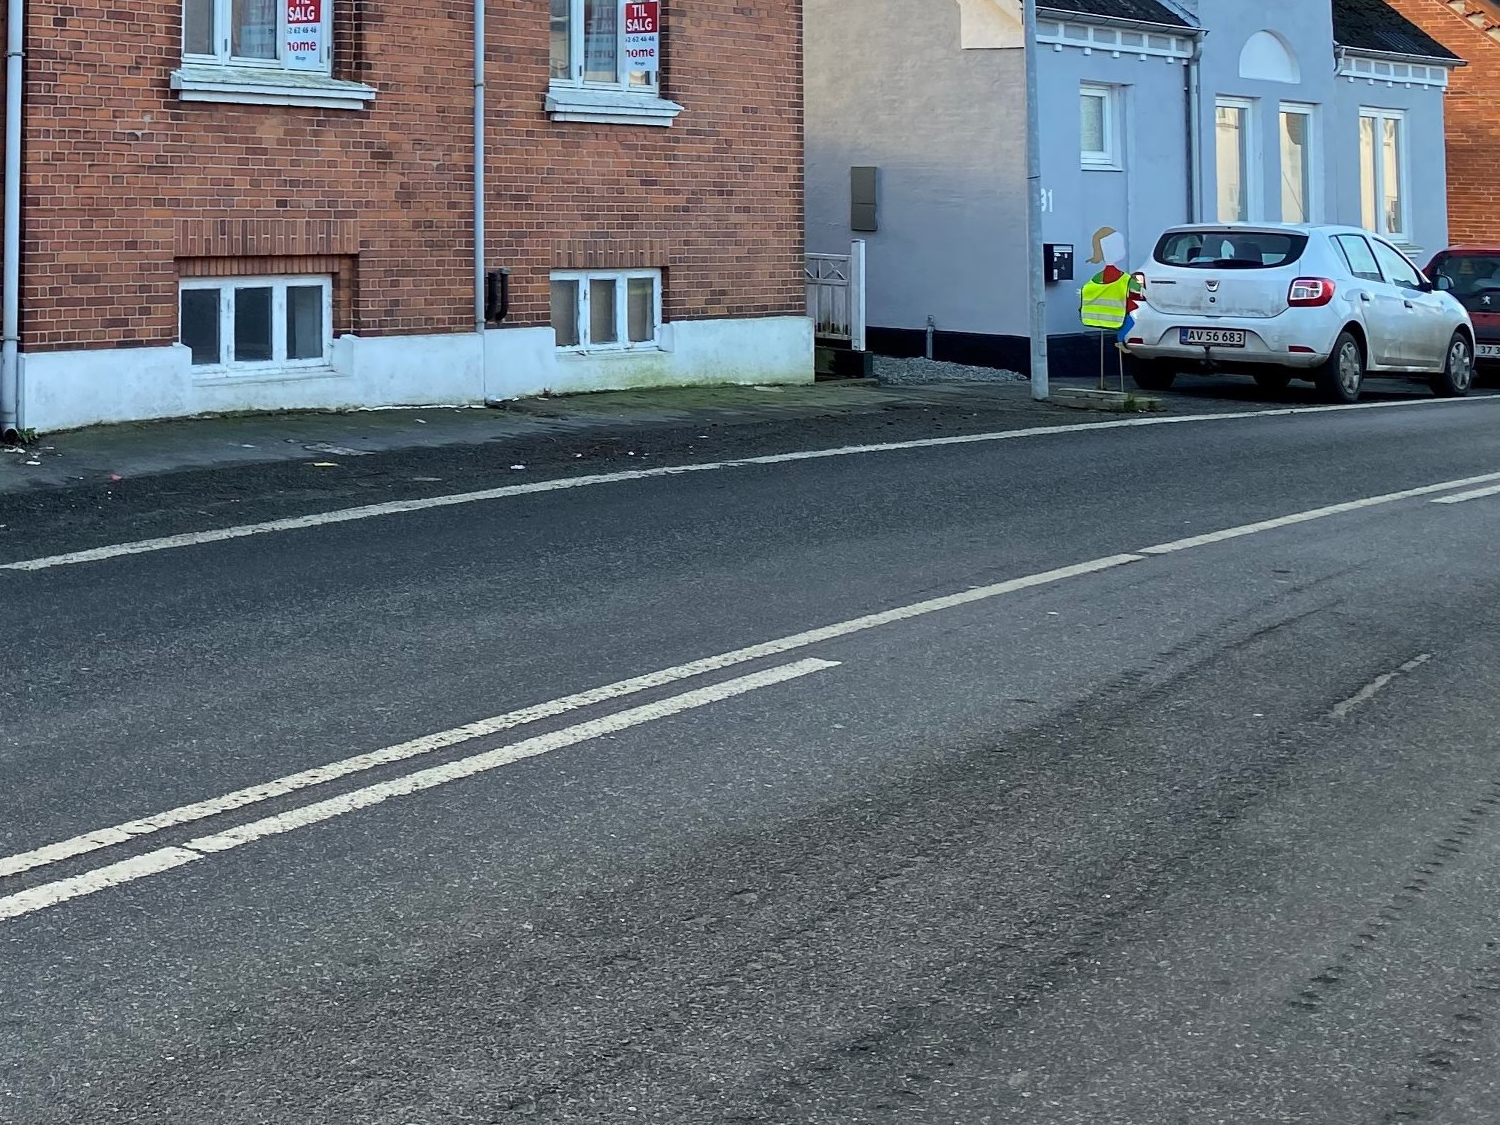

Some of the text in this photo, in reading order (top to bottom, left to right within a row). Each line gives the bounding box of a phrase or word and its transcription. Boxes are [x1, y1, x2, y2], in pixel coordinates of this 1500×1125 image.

[288, 5, 315, 22] SALG
[631, 4, 648, 17] TIL
[626, 18, 653, 32] SALG
[1188, 330, 1203, 341] AV
[1205, 331, 1219, 342] 56
[1222, 331, 1242, 343] 683
[1480, 345, 1492, 355] 37
